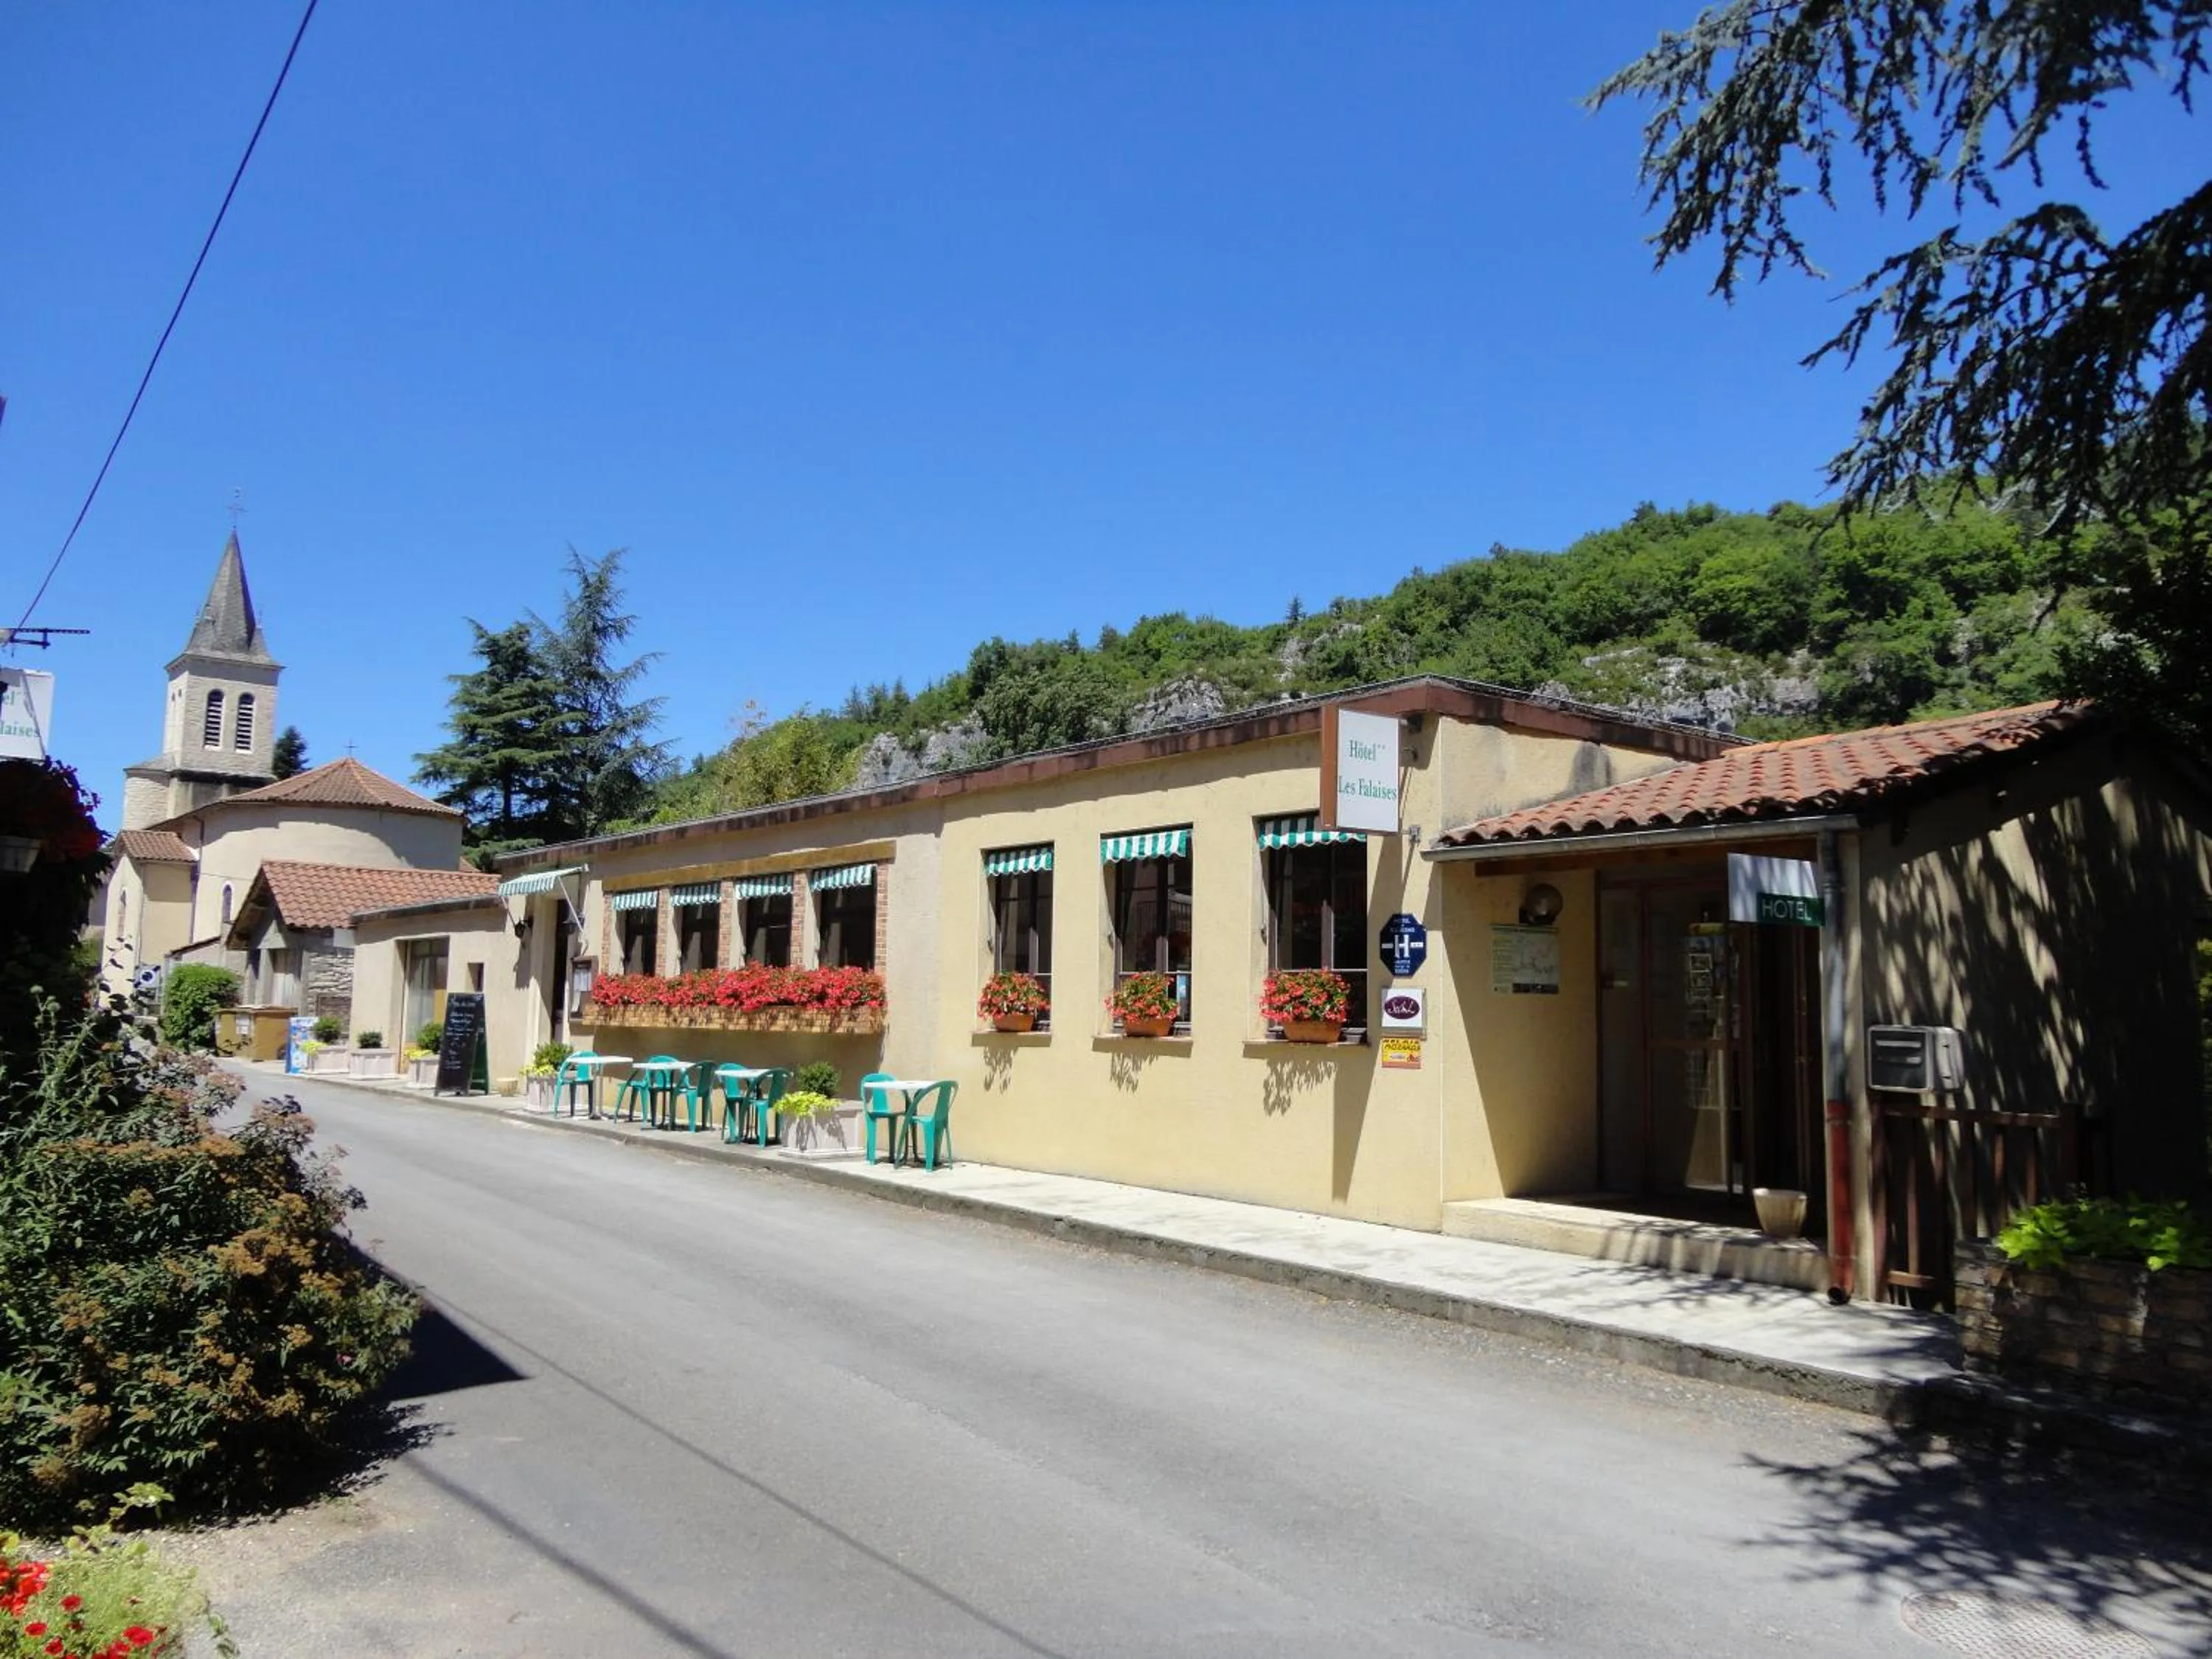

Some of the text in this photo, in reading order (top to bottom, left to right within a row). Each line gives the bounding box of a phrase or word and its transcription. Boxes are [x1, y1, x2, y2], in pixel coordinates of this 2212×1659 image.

[1338, 776, 1397, 801] Les Falaises
[1761, 900, 1812, 921] HOTEL
